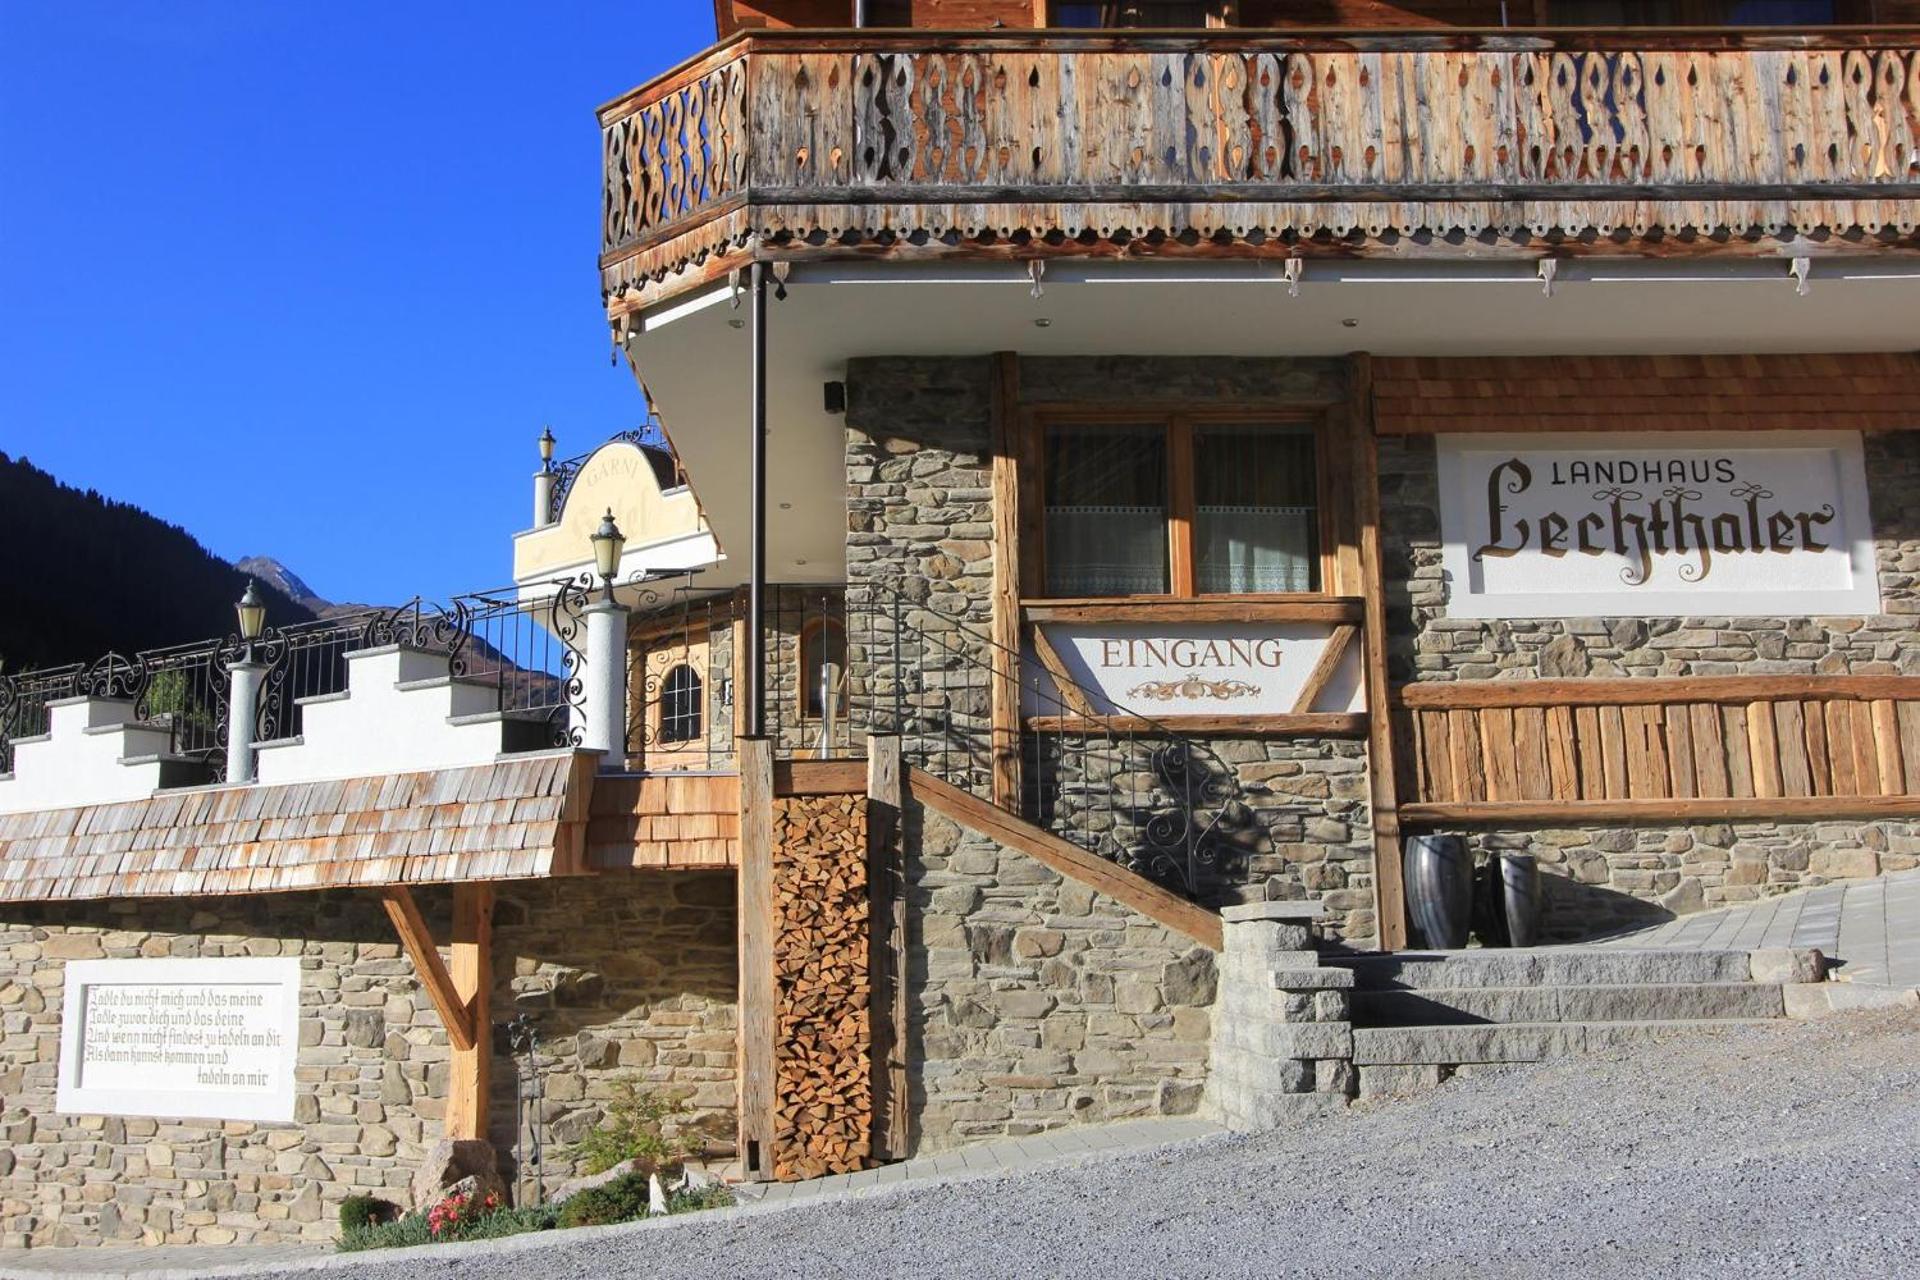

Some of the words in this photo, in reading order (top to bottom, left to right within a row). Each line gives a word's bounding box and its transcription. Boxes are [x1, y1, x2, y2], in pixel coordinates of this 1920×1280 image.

[585, 456, 640, 488] GARNI
[1551, 458, 1736, 484] LANDHAUS
[1472, 457, 1836, 586] Lechthaler
[1100, 638, 1283, 668] EINGANG
[88, 986, 119, 1007] Tadle
[120, 989, 134, 1006] du
[135, 988, 160, 1011] nicht
[161, 989, 184, 1010] mich
[186, 989, 206, 1006] und
[208, 989, 228, 1006] das
[229, 991, 264, 1007] meine
[88, 1007, 117, 1025] Tadle
[118, 1012, 147, 1028] zuvor
[149, 1009, 170, 1028] dich
[171, 1009, 192, 1026] und
[194, 1009, 213, 1026] das
[215, 1010, 245, 1026] deine
[87, 1028, 110, 1044] Und
[112, 1031, 141, 1044] wenn
[142, 1027, 167, 1048] nicht
[168, 1028, 203, 1048] findest
[204, 1033, 217, 1049] zu
[218, 1029, 250, 1047] tadeln
[251, 1034, 264, 1047] an
[265, 1029, 281, 1047] dir
[164, 1049, 205, 1066] kommen
[207, 1050, 229, 1065] und
[198, 1066, 230, 1086] tadeln
[232, 1073, 246, 1086] an
[247, 1069, 270, 1087] mir
